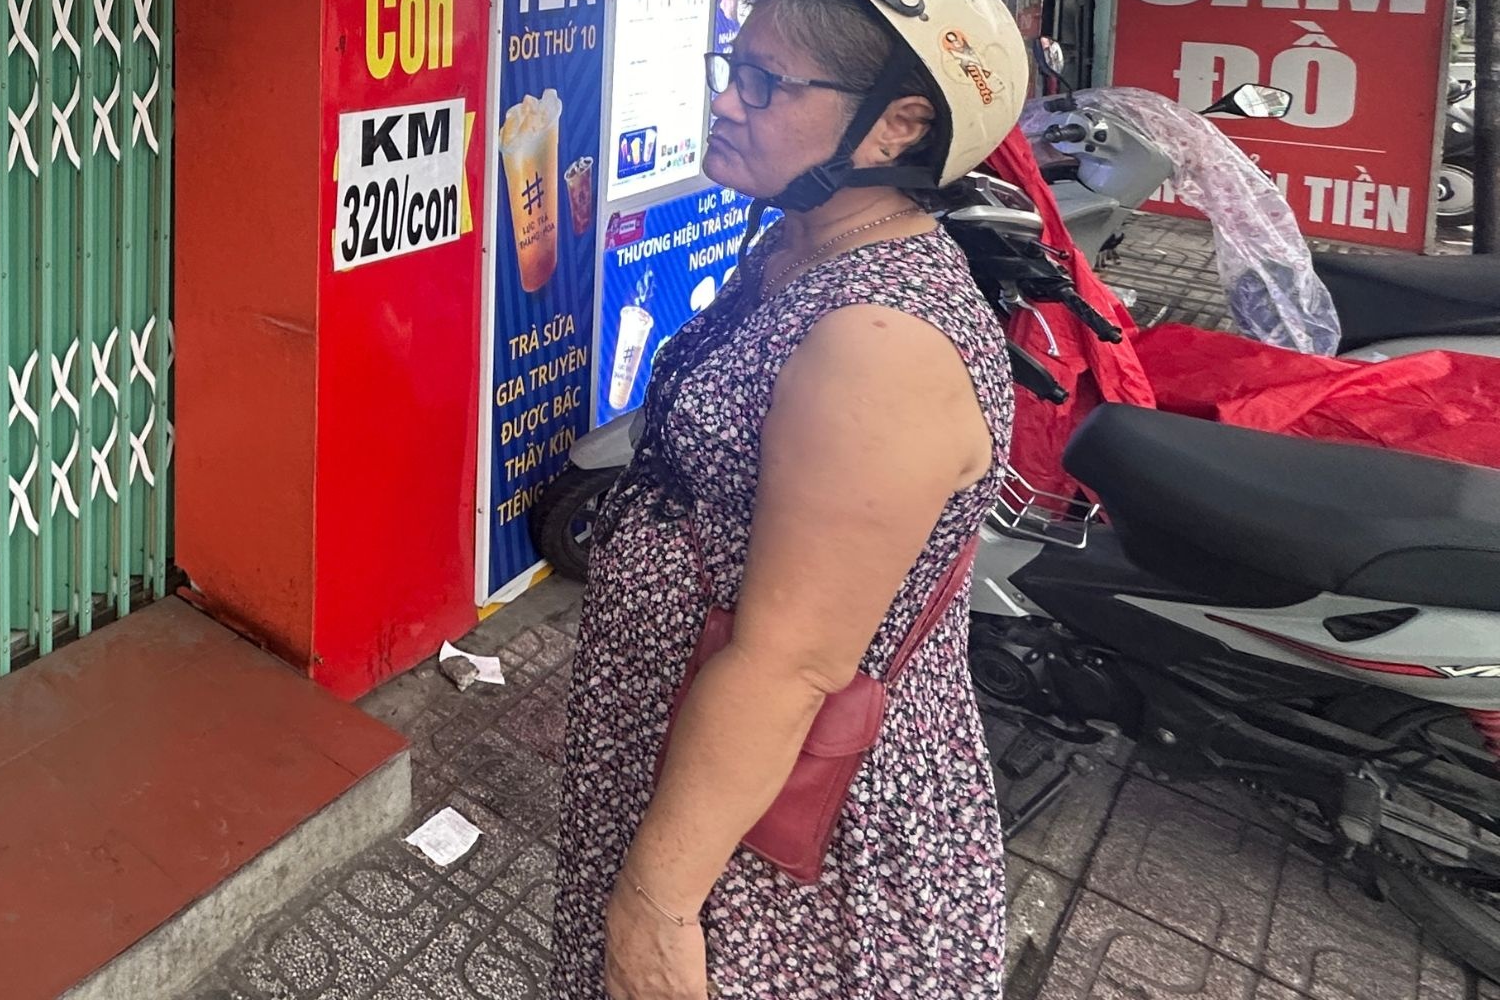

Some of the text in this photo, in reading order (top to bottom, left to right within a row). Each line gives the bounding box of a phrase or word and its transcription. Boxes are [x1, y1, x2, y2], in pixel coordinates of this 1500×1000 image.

[508, 21, 596, 62] ĐỜI THỨ 10
[1173, 20, 1357, 128] ĐỒ
[361, 108, 451, 167] KM
[341, 175, 458, 262] 320/con
[1304, 165, 1410, 234] TIỀN
[617, 207, 743, 268] THƯƠNG HIỆU TRÀ SỮA
[689, 242, 724, 272] NGON
[509, 313, 575, 360] TRÀ SỮA
[496, 375, 525, 407] GIA
[529, 345, 588, 392] TRUYỀN
[501, 385, 581, 446] ĐƯỢC BẬC
[505, 442, 549, 483] THẦY
[550, 425, 576, 458] KÍN
